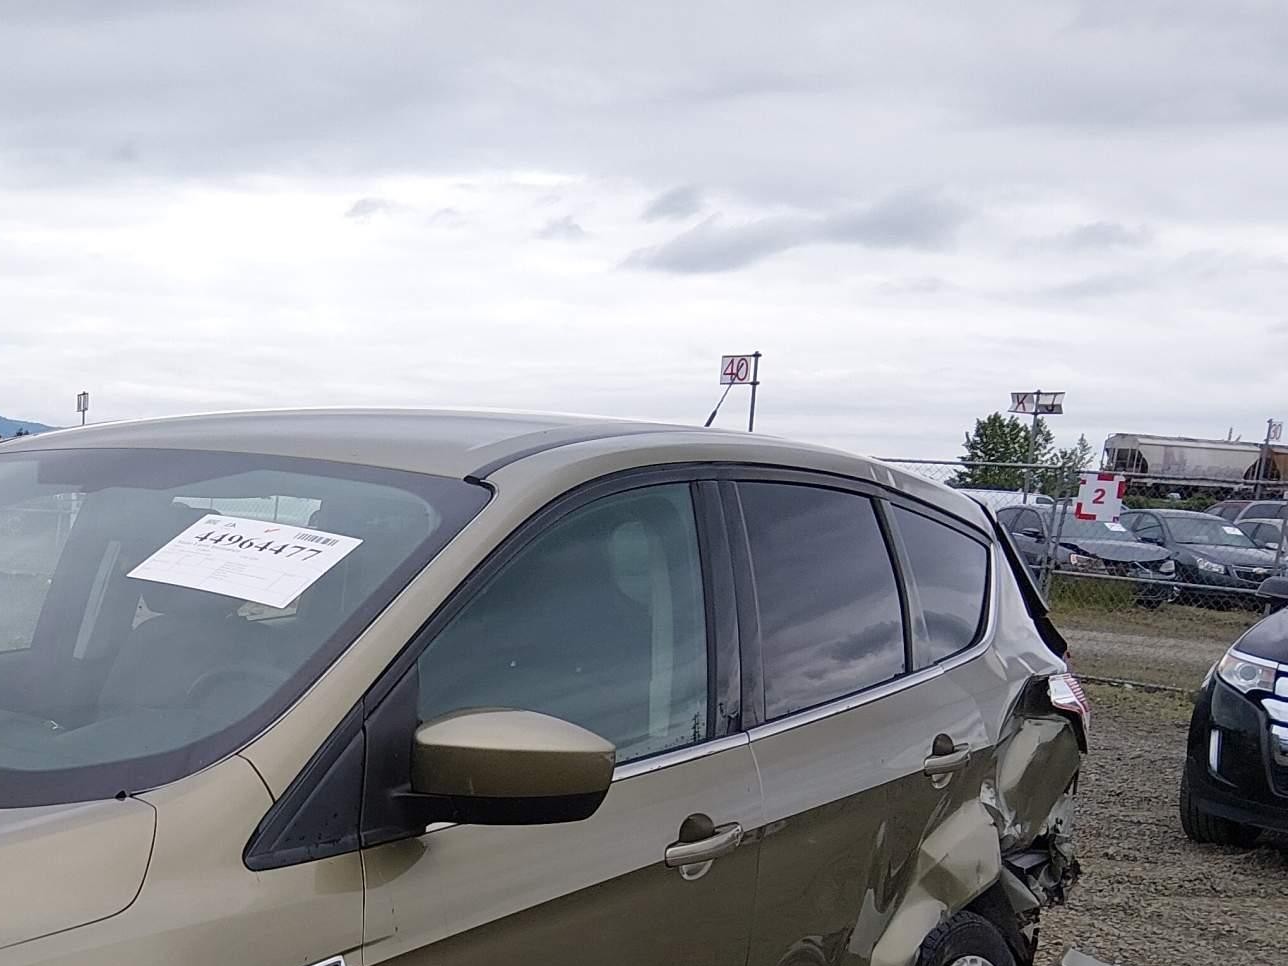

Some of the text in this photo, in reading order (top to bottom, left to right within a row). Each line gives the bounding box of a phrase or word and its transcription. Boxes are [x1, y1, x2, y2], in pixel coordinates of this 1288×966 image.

[723, 357, 749, 381] 40
[1015, 393, 1028, 412] K
[1045, 393, 1057, 412] J
[1092, 488, 1107, 505] 2
[194, 530, 323, 562] 44964477
